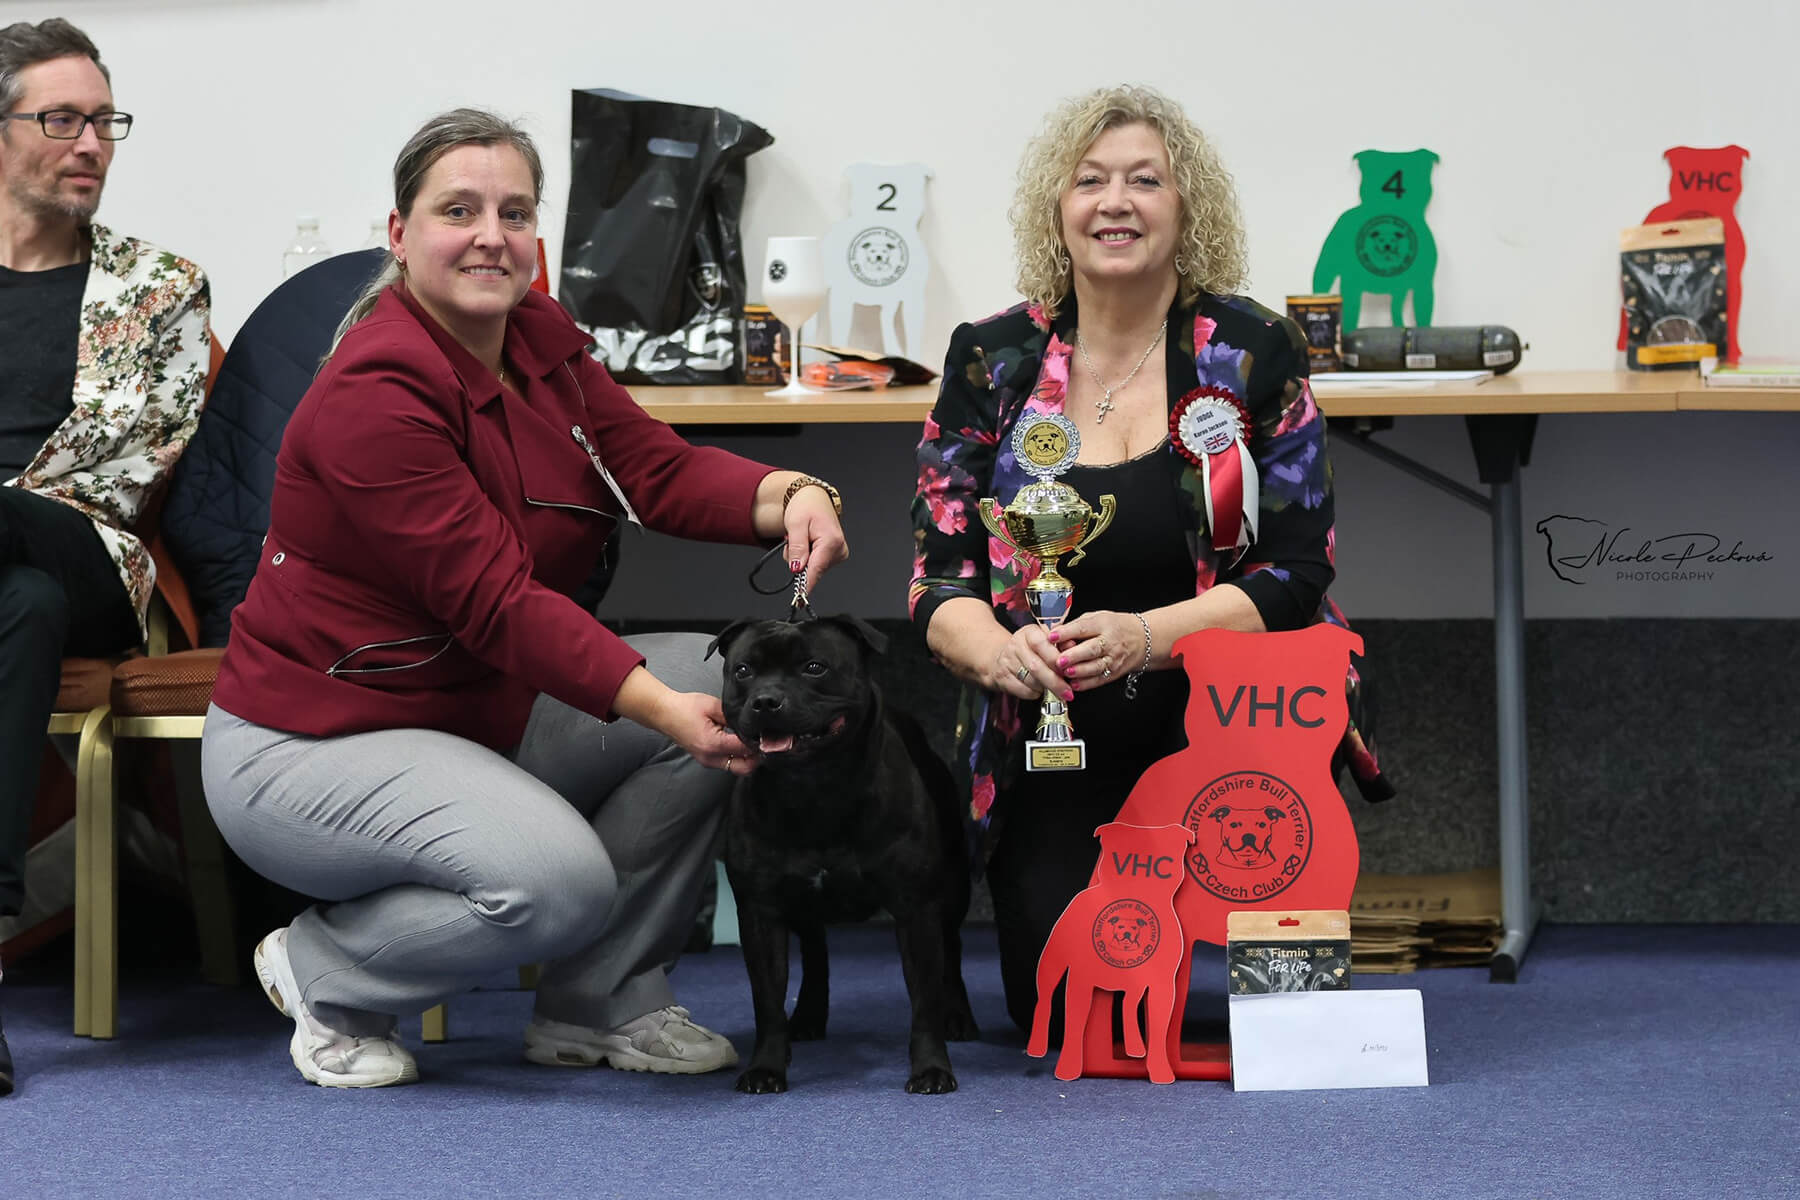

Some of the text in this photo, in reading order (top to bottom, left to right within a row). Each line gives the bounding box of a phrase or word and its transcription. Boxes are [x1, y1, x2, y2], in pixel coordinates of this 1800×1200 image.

[1381, 169, 1407, 200] 4
[1679, 170, 1733, 192] VHC
[876, 183, 897, 211] 2
[1196, 411, 1214, 423] JUDGE
[1208, 420, 1228, 432] Jackson
[1207, 684, 1327, 728] VHC
[1190, 778, 1305, 850] affordshire Bull Terrier
[1112, 851, 1174, 879] VHC
[1206, 874, 1284, 898] Czech Club
[1271, 947, 1309, 957] Fitmin
